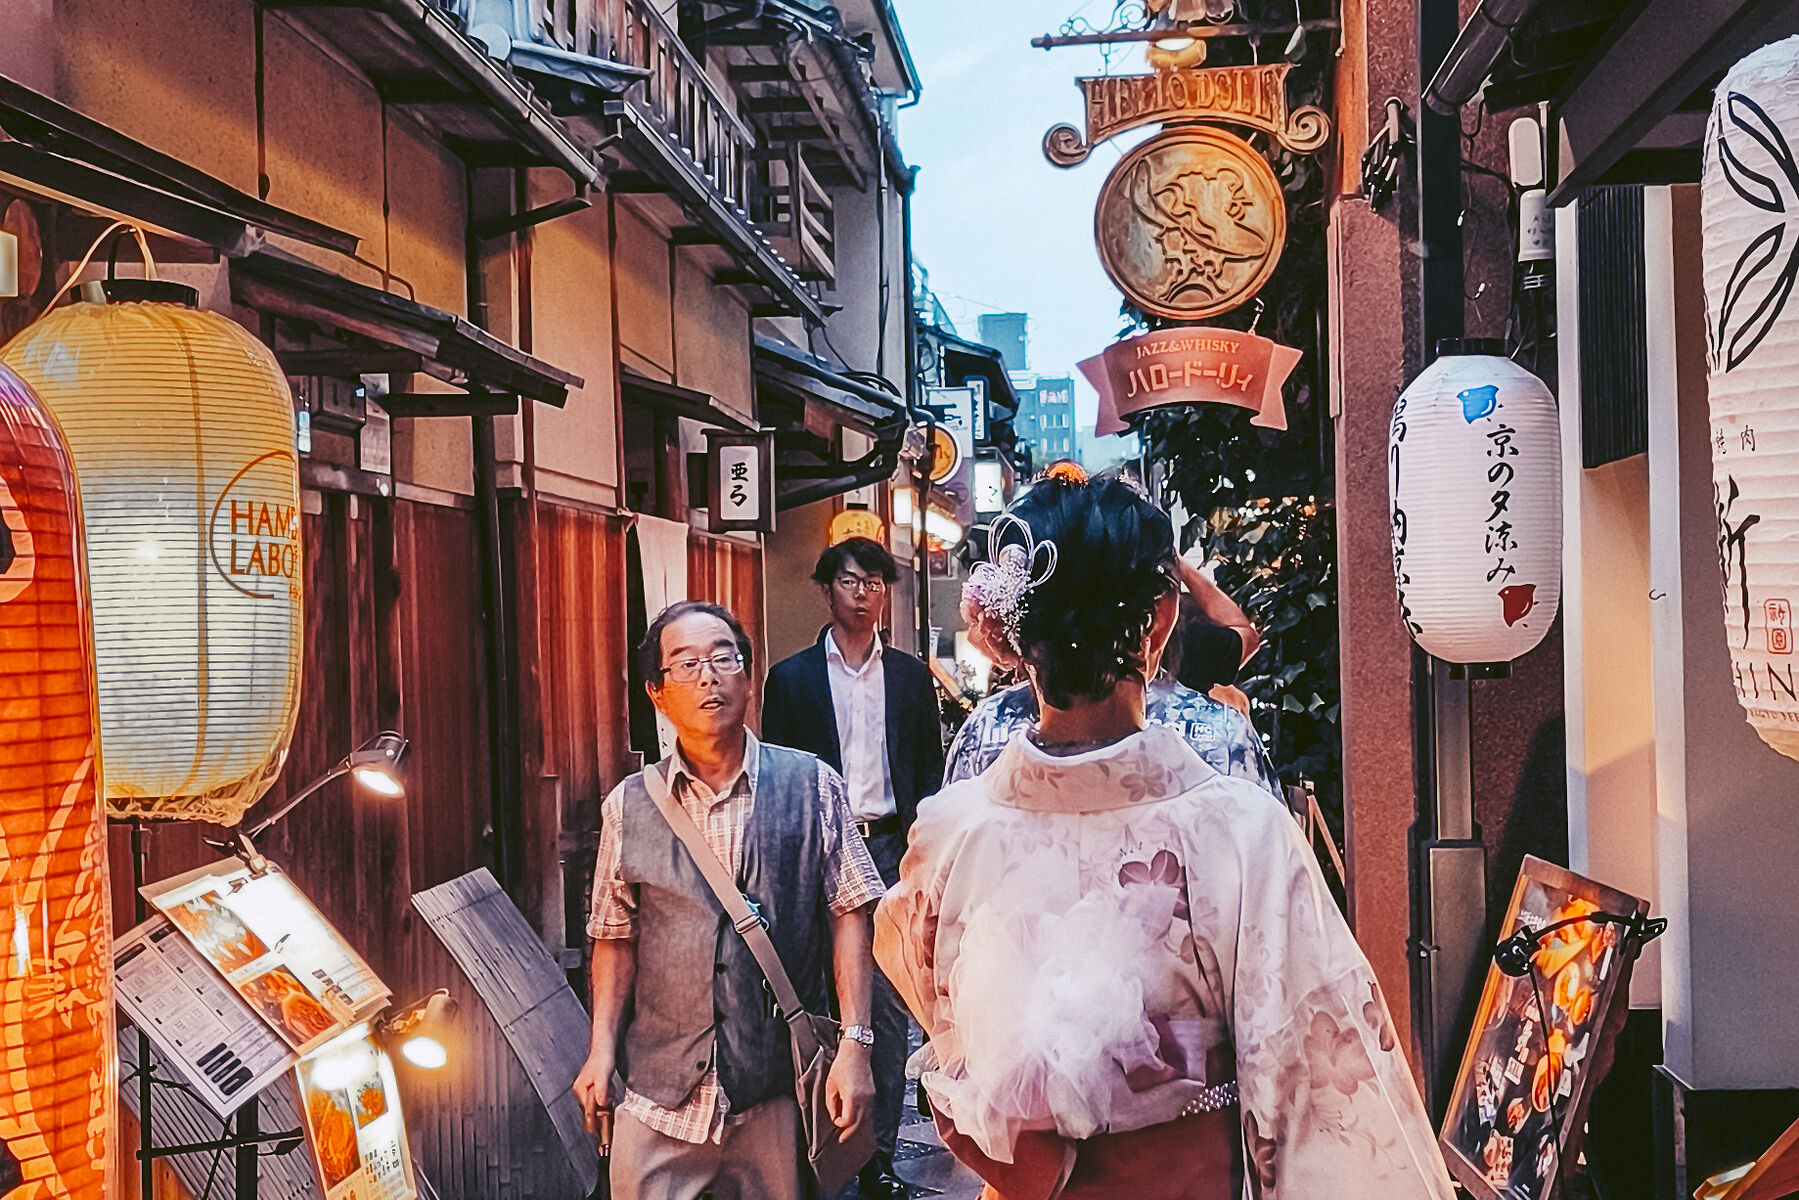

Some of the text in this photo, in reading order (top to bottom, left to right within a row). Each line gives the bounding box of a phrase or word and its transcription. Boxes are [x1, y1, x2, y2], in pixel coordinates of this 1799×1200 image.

[1136, 338, 1240, 359] JAZZ&WHISKY
[1127, 361, 1253, 398] ハロードーリィ
[1484, 424, 1519, 583] 京の夕涼み
